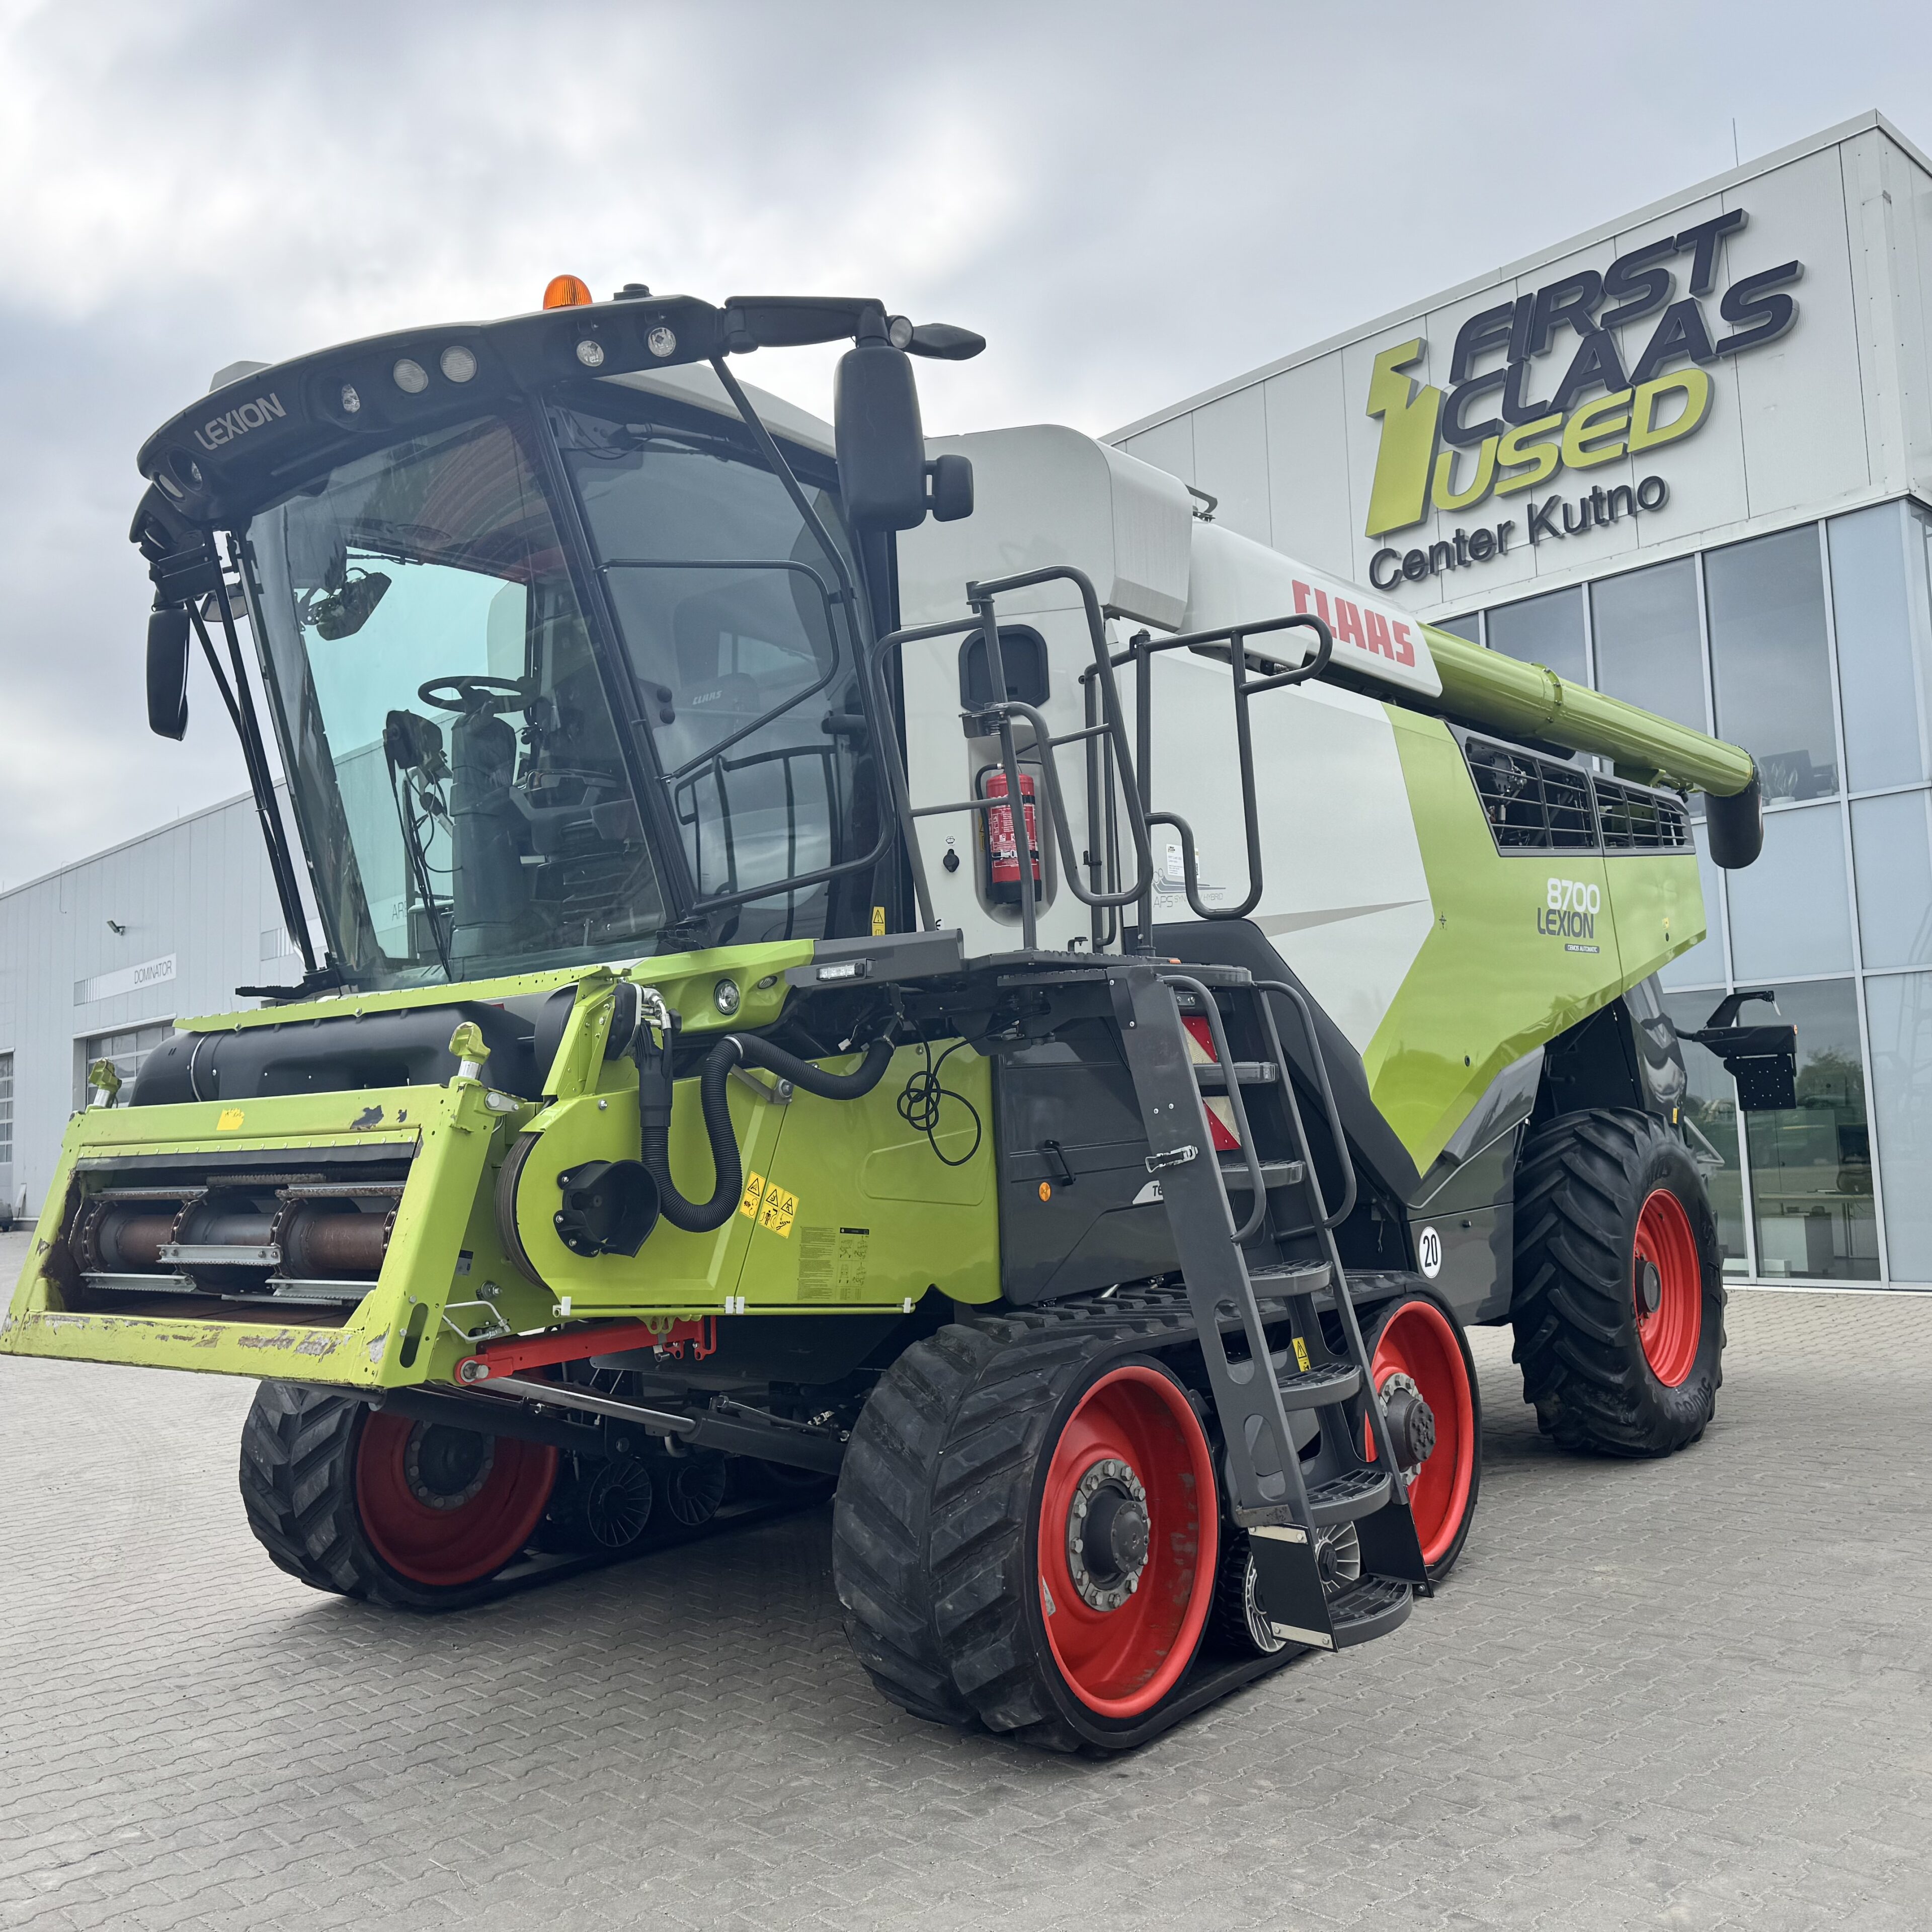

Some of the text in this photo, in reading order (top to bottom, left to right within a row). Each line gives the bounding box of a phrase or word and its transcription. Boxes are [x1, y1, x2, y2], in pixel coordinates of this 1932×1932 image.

[1449, 208, 1749, 385] FIRST
[1442, 261, 1804, 447] CLAAS
[194, 393, 287, 450] LEXION
[1431, 368, 1713, 511] USED
[1369, 476, 1670, 590] Center Kutno
[1292, 580, 1415, 667] CLAAS
[1153, 896, 1173, 908] APS
[1537, 907, 1594, 939] LEXION
[1547, 877, 1600, 914] 8700
[134, 960, 172, 984] DOMINATOR
[1423, 1234, 1438, 1267] 20
